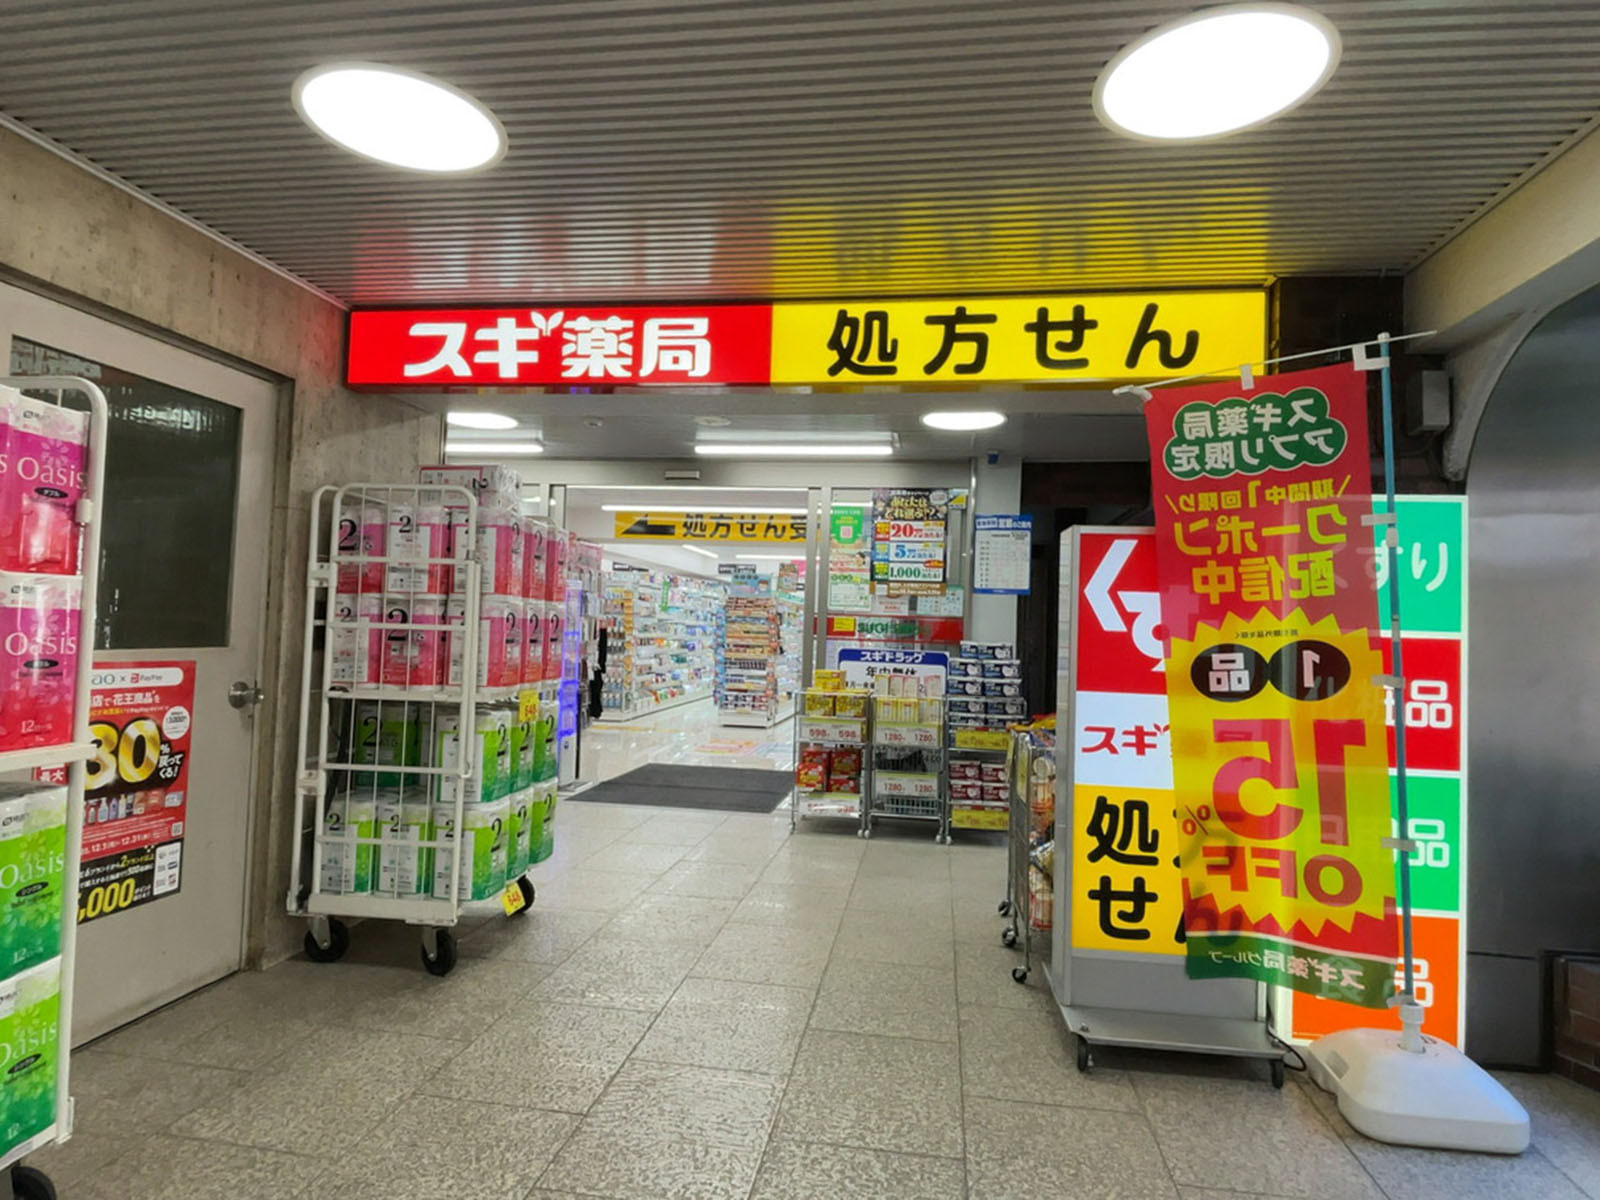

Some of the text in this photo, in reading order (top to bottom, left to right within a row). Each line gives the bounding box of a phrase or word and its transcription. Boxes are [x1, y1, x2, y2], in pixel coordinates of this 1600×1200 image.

[403, 309, 712, 381] スギ薬局
[827, 302, 1200, 382] 処方せん
[17, 457, 88, 490] Oasis
[339, 519, 357, 551] 2
[399, 515, 411, 533] 2
[891, 523, 914, 538] 20
[894, 544, 907, 558] 5
[890, 567, 921, 579] 1,000
[5, 631, 77, 657] Oasis
[860, 651, 926, 663] スギドラッグ
[92, 673, 116, 686] ao
[329, 813, 341, 832] 2
[0, 851, 65, 890] Oasis
[77, 877, 136, 922] ,000
